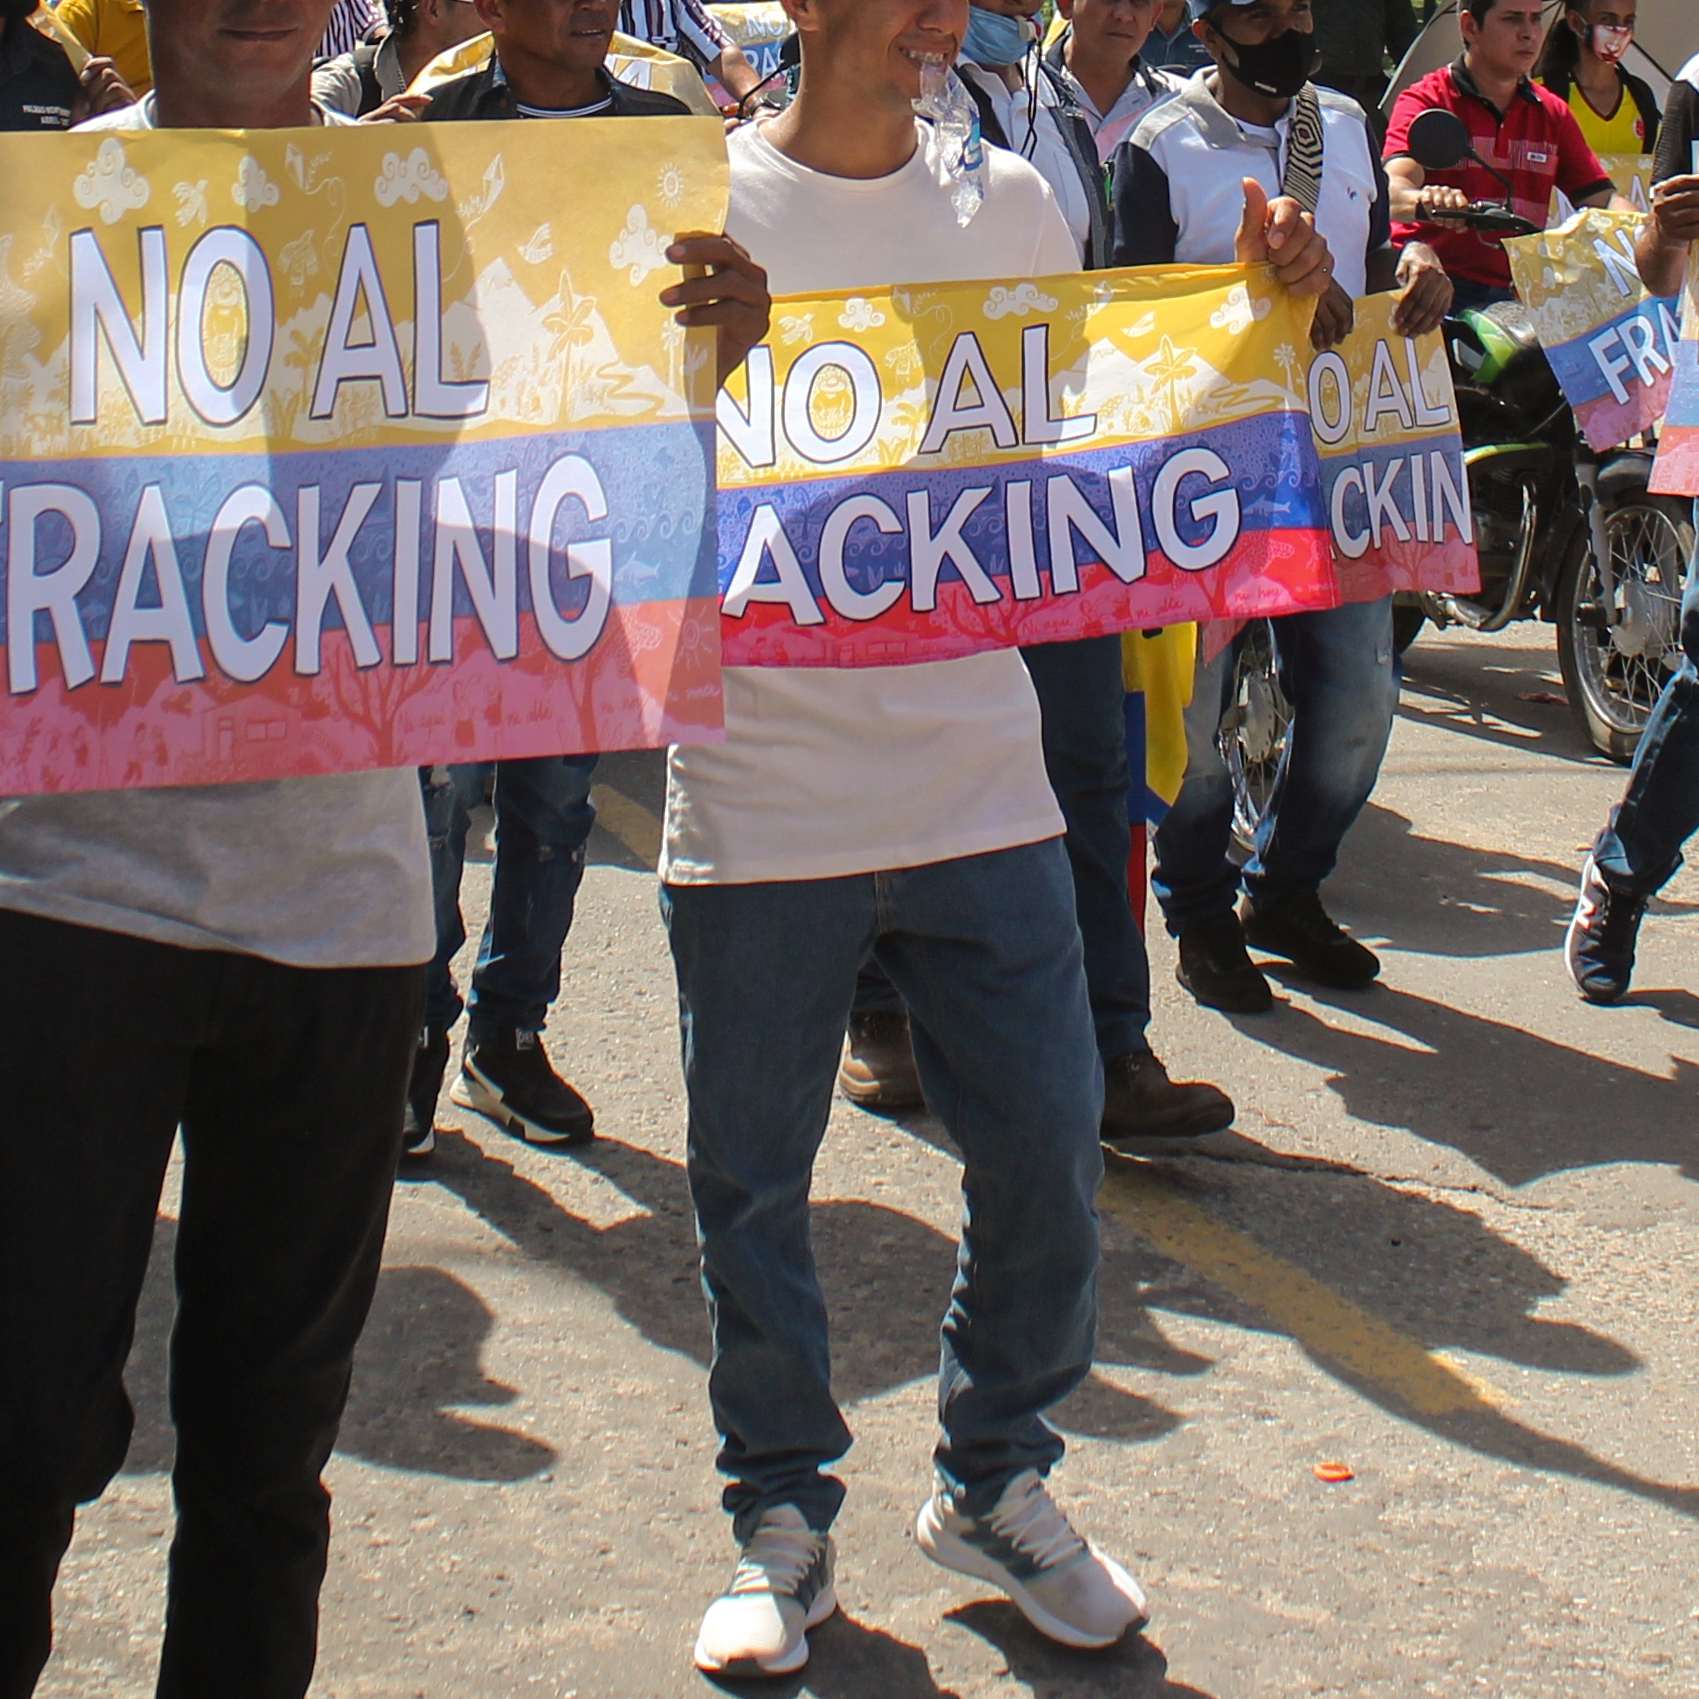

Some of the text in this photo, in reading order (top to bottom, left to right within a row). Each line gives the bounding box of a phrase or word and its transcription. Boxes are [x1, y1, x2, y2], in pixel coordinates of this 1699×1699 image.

[68, 220, 490, 427] NO AL
[918, 324, 1097, 455] AL
[1307, 337, 1452, 444] O AL
[720, 446, 1242, 628] ACKING
[1330, 450, 1474, 560] CKIN
